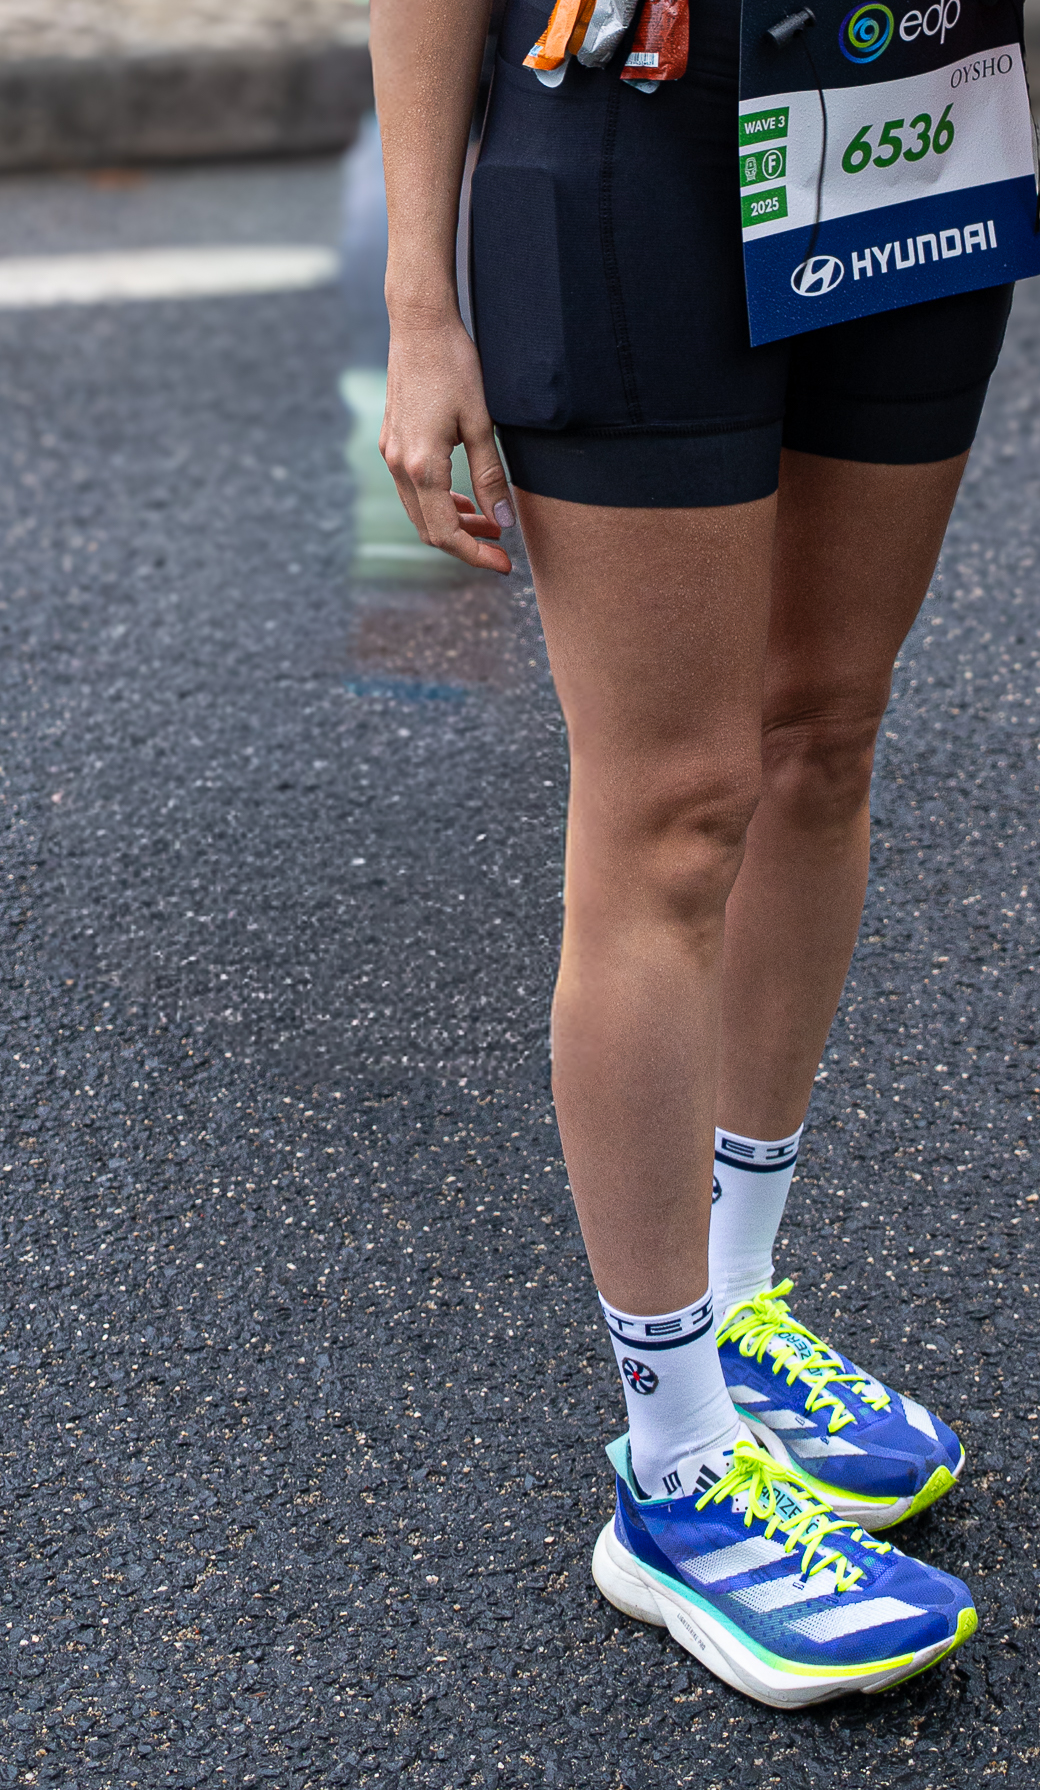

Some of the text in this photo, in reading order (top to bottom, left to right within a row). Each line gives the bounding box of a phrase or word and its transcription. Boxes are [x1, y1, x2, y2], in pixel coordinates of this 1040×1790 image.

[950, 53, 1013, 89] OYSHO
[744, 115, 786, 135] WAVE 3
[841, 102, 955, 174] 6536
[768, 154, 777, 174] F
[750, 196, 779, 217] 2025
[851, 220, 998, 281] HYUNDAI
